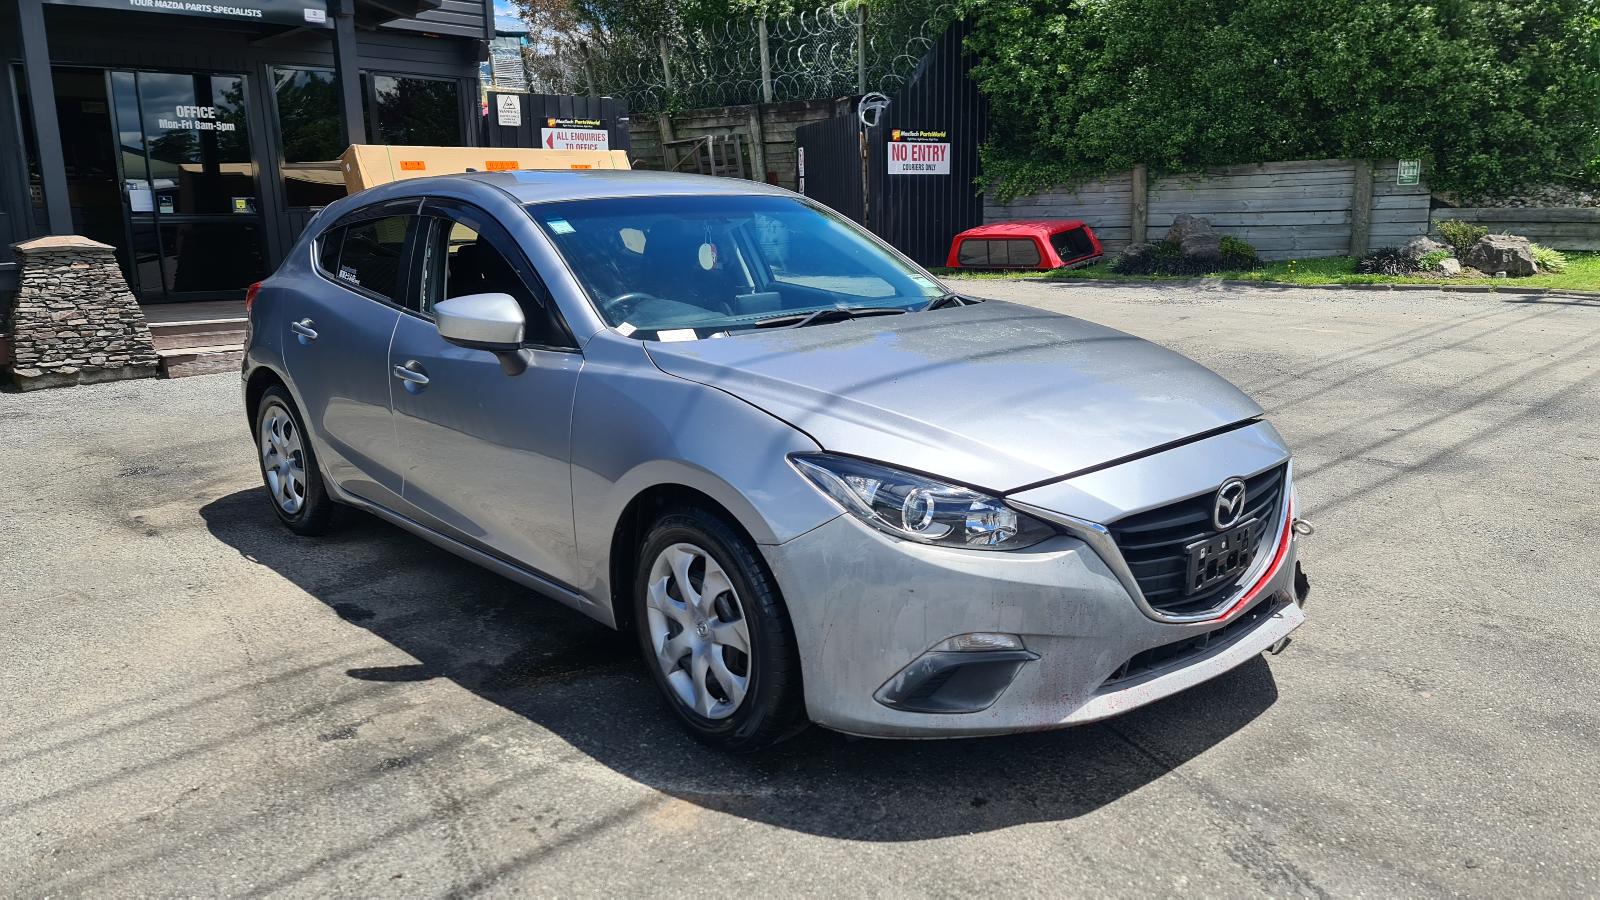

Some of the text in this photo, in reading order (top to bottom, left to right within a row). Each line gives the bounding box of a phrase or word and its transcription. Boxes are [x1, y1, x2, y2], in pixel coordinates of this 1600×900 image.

[154, 0, 184, 10] MAZDA
[185, 2, 211, 13] PARTS
[212, 5, 262, 17] SPECIALISTS
[175, 105, 216, 119] OFFICE
[158, 118, 235, 132] Mon-Fri 8am-5pm
[556, 131, 606, 142] ALL ENQUIRIES
[891, 143, 947, 162] NO ENTRY
[902, 163, 937, 171] COURIERS ONLY
